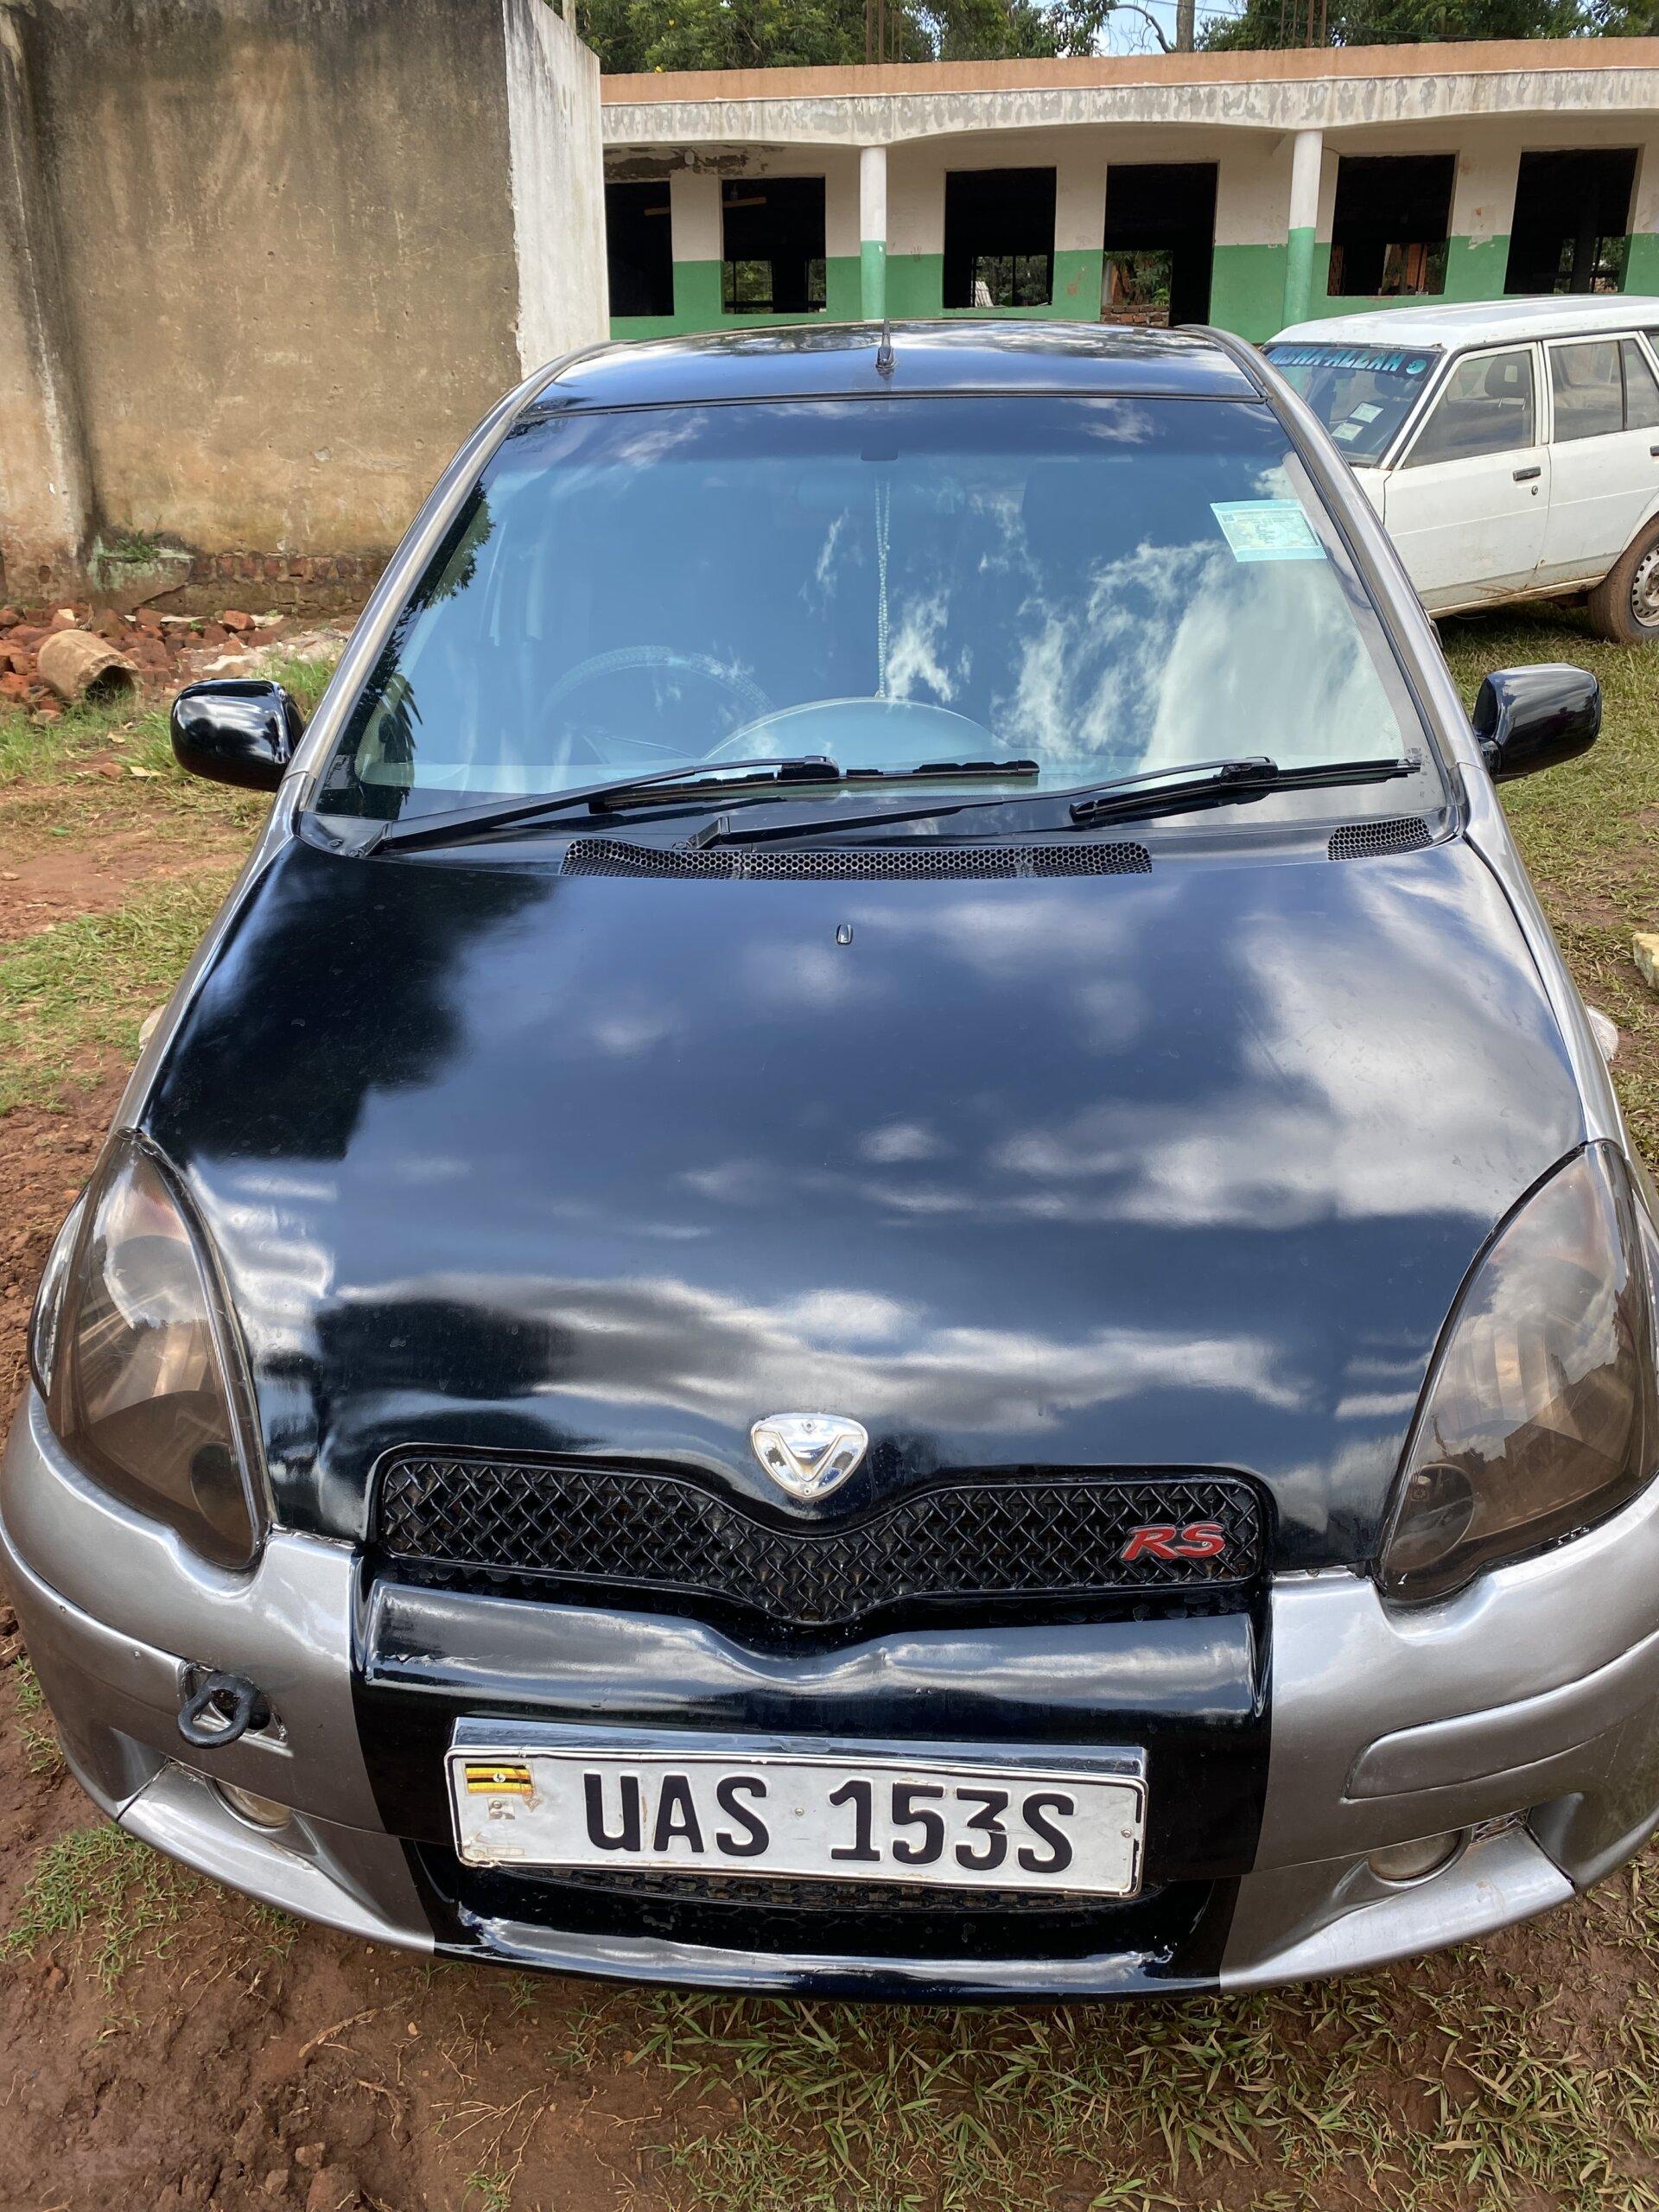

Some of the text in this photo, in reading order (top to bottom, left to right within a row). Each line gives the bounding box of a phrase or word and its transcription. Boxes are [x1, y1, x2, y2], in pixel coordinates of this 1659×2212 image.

[1120, 1522, 1226, 1561] RS
[583, 1772, 1076, 1874] UAS 153S
